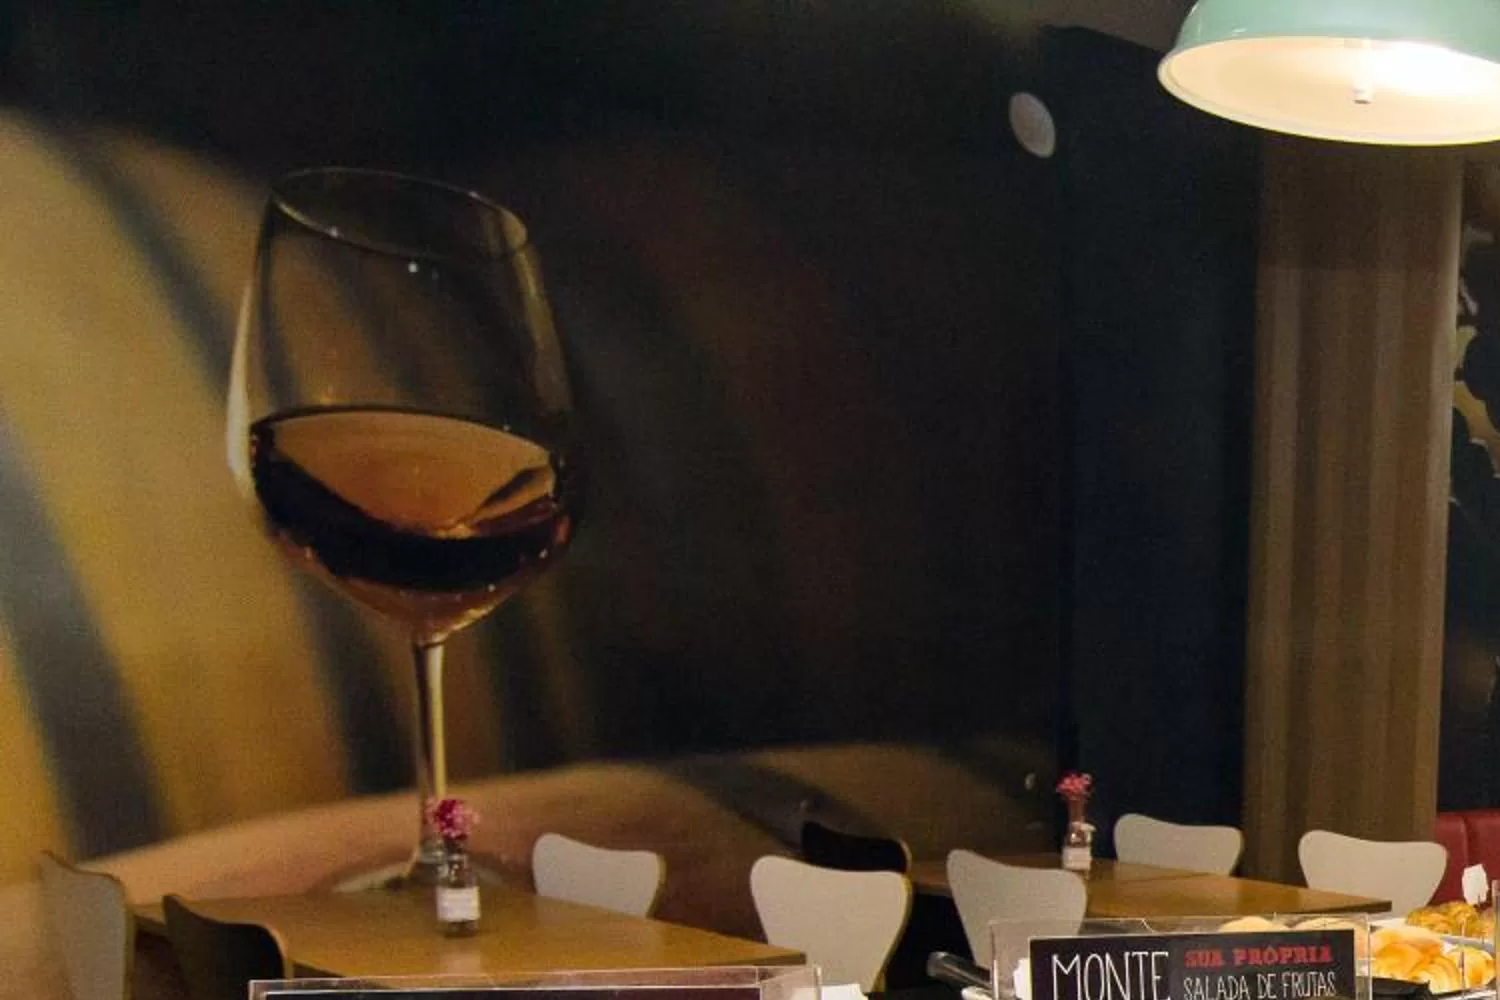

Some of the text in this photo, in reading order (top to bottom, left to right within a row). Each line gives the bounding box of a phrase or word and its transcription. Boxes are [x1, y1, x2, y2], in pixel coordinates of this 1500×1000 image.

[1183, 949, 1226, 968] SUA
[1233, 944, 1333, 967] PRÓPRIA
[1257, 973, 1277, 999] DE
[1281, 971, 1337, 999] FRUTAS
